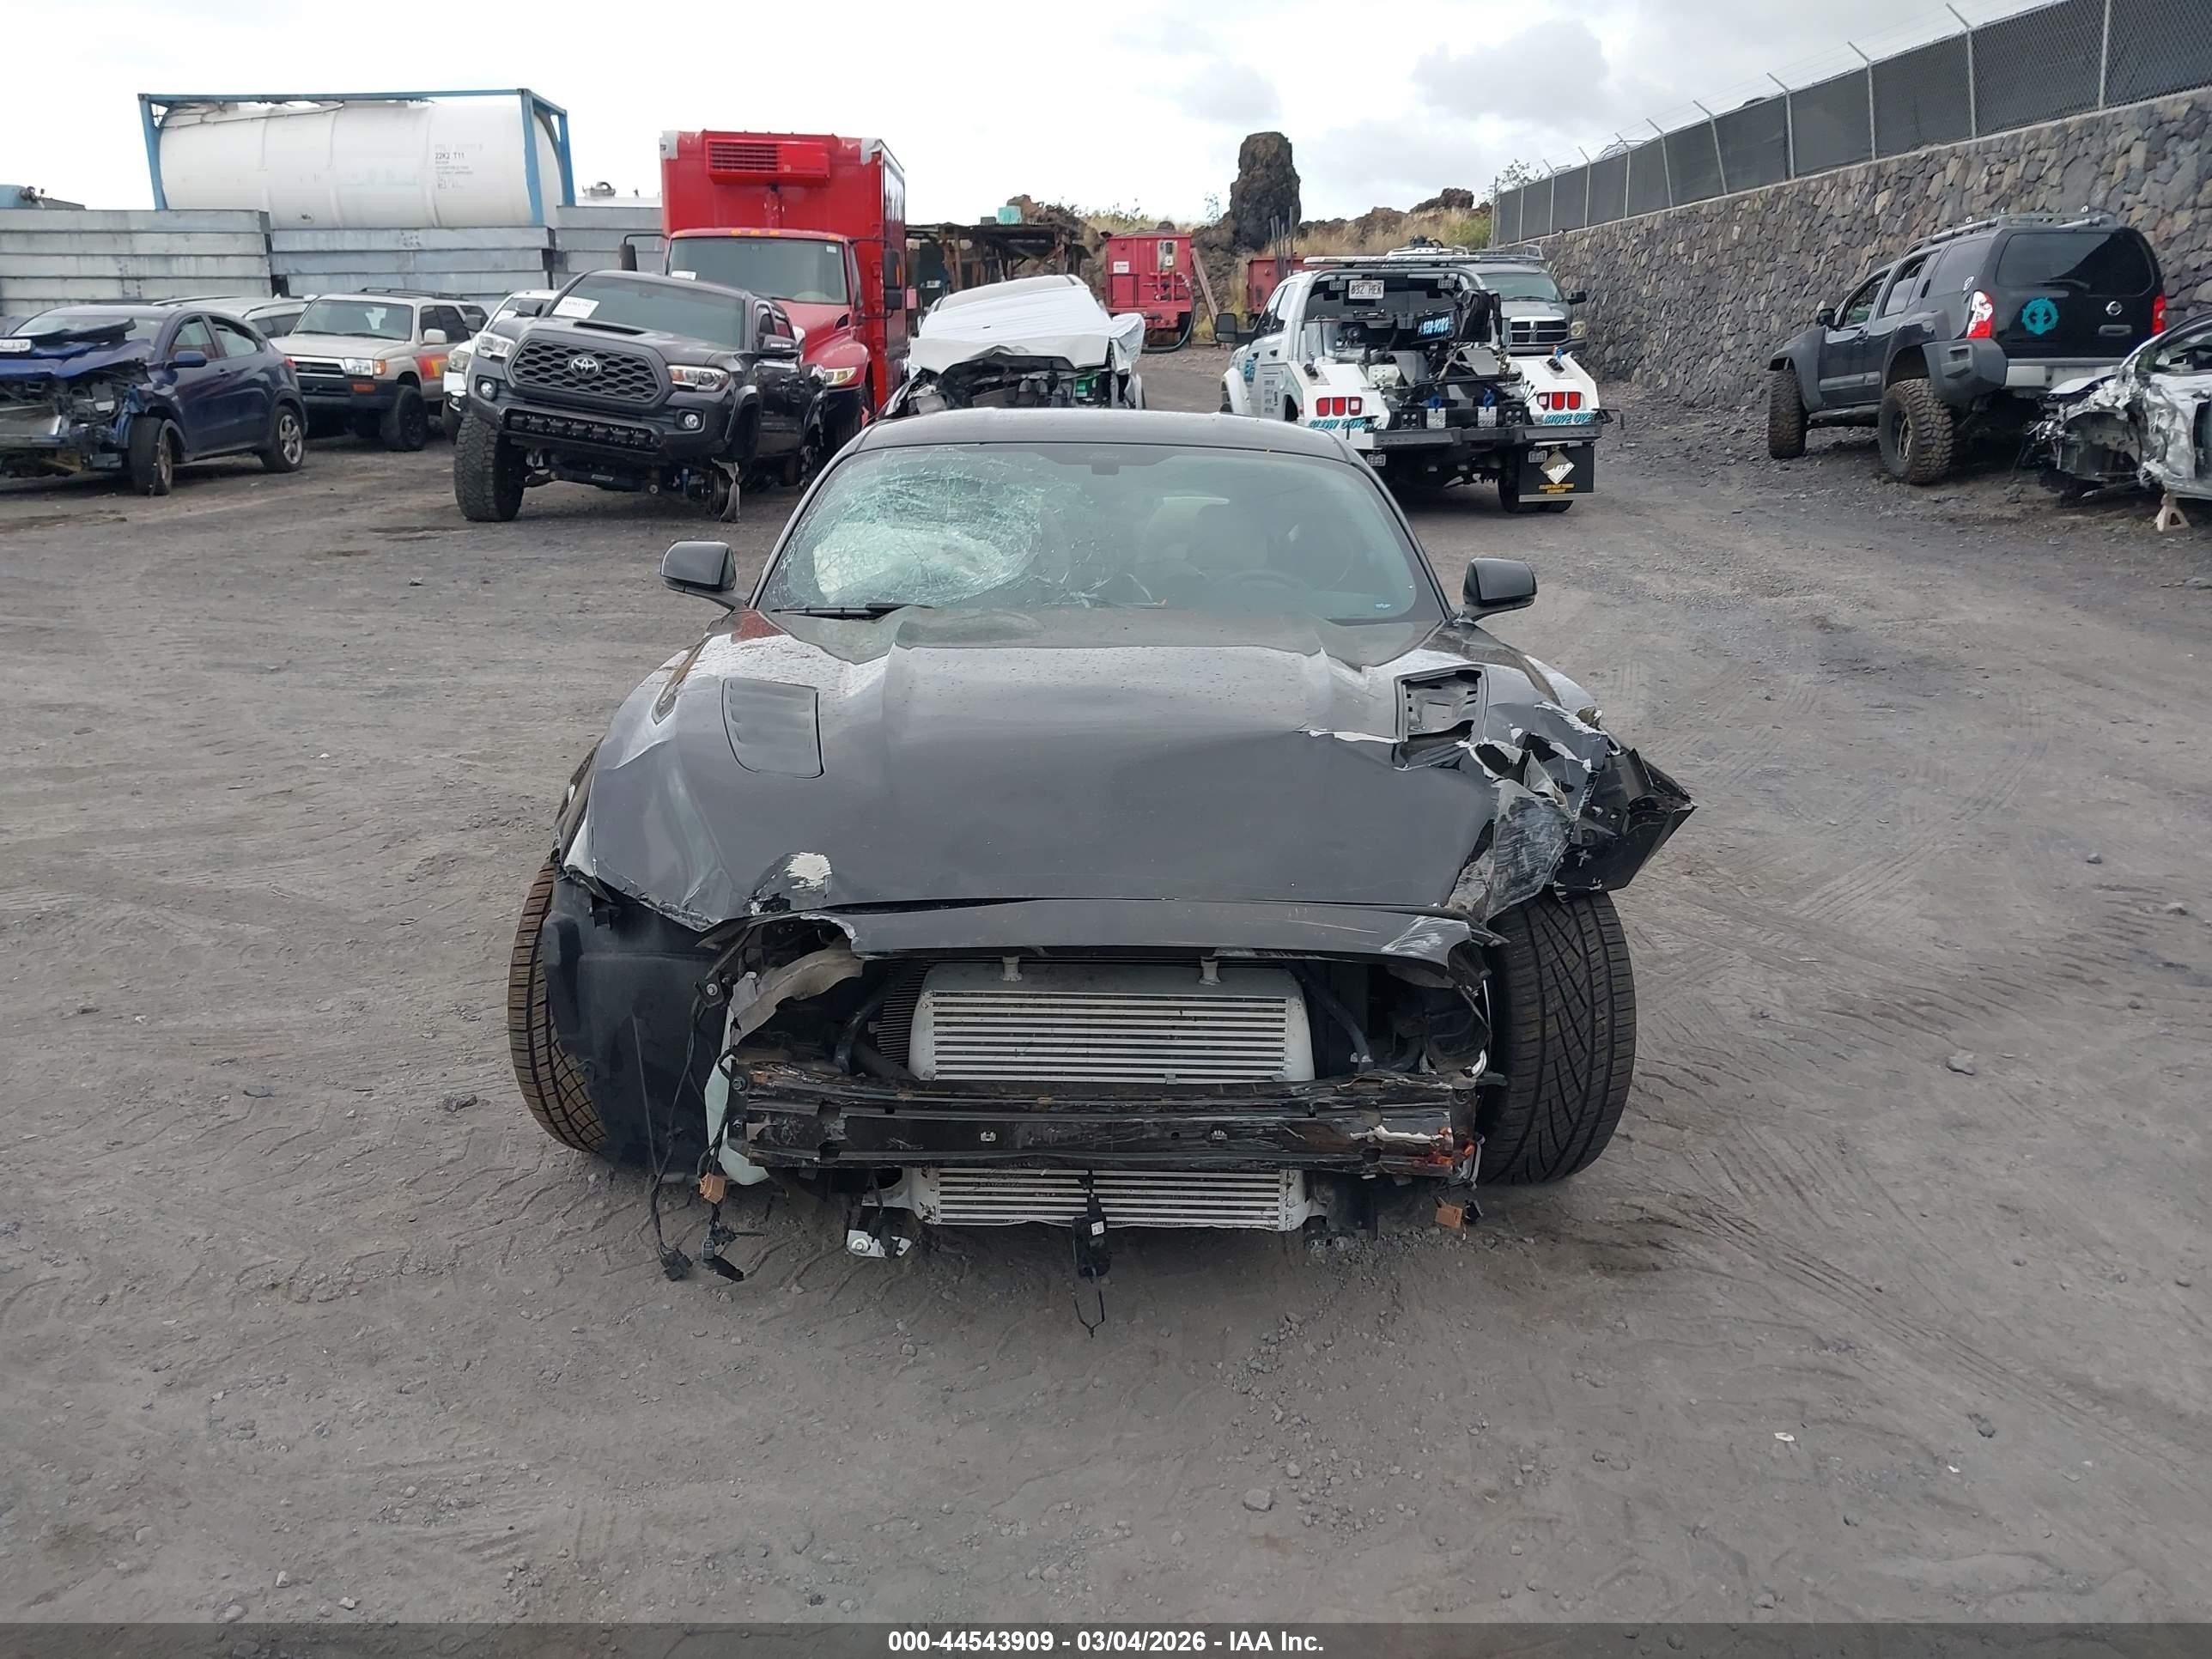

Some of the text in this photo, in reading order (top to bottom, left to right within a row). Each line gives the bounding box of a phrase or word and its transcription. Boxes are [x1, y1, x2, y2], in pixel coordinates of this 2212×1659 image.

[1308, 418, 1340, 429] SLOW
[1545, 412, 1595, 425] MOVE OVE
